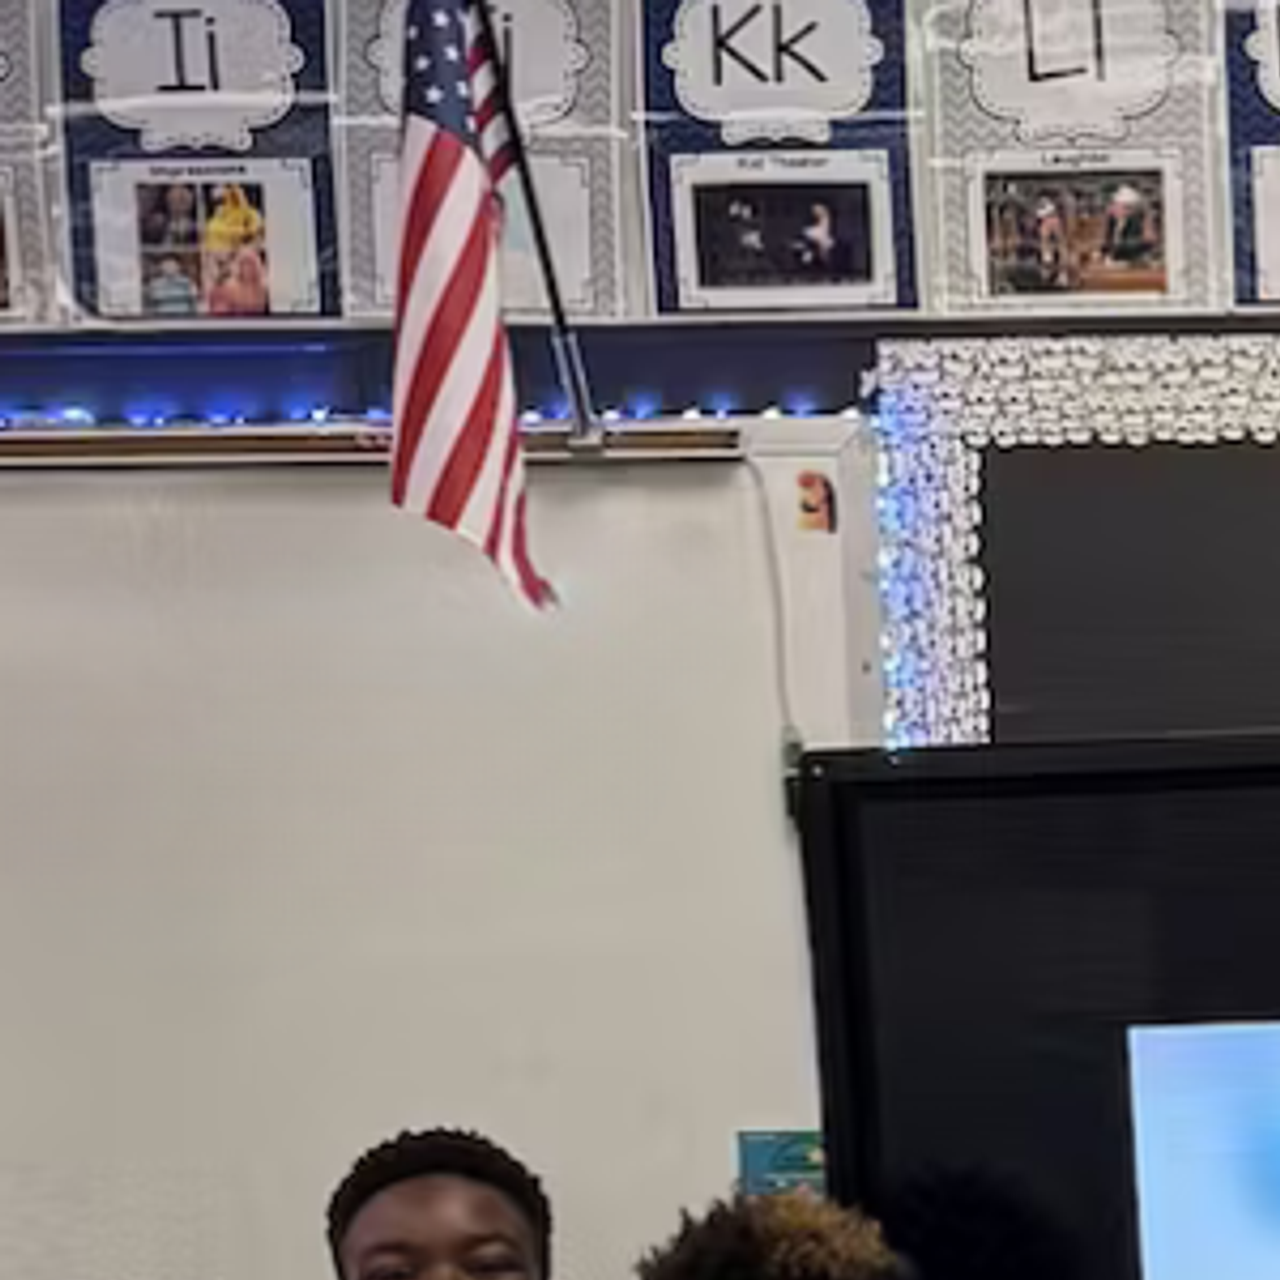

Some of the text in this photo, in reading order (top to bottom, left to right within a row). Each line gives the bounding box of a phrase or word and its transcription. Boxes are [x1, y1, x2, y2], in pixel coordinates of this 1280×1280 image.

[153, 10, 220, 91] Ii
[711, 3, 828, 85] Kk
[1021, 0, 1107, 82] Ll
